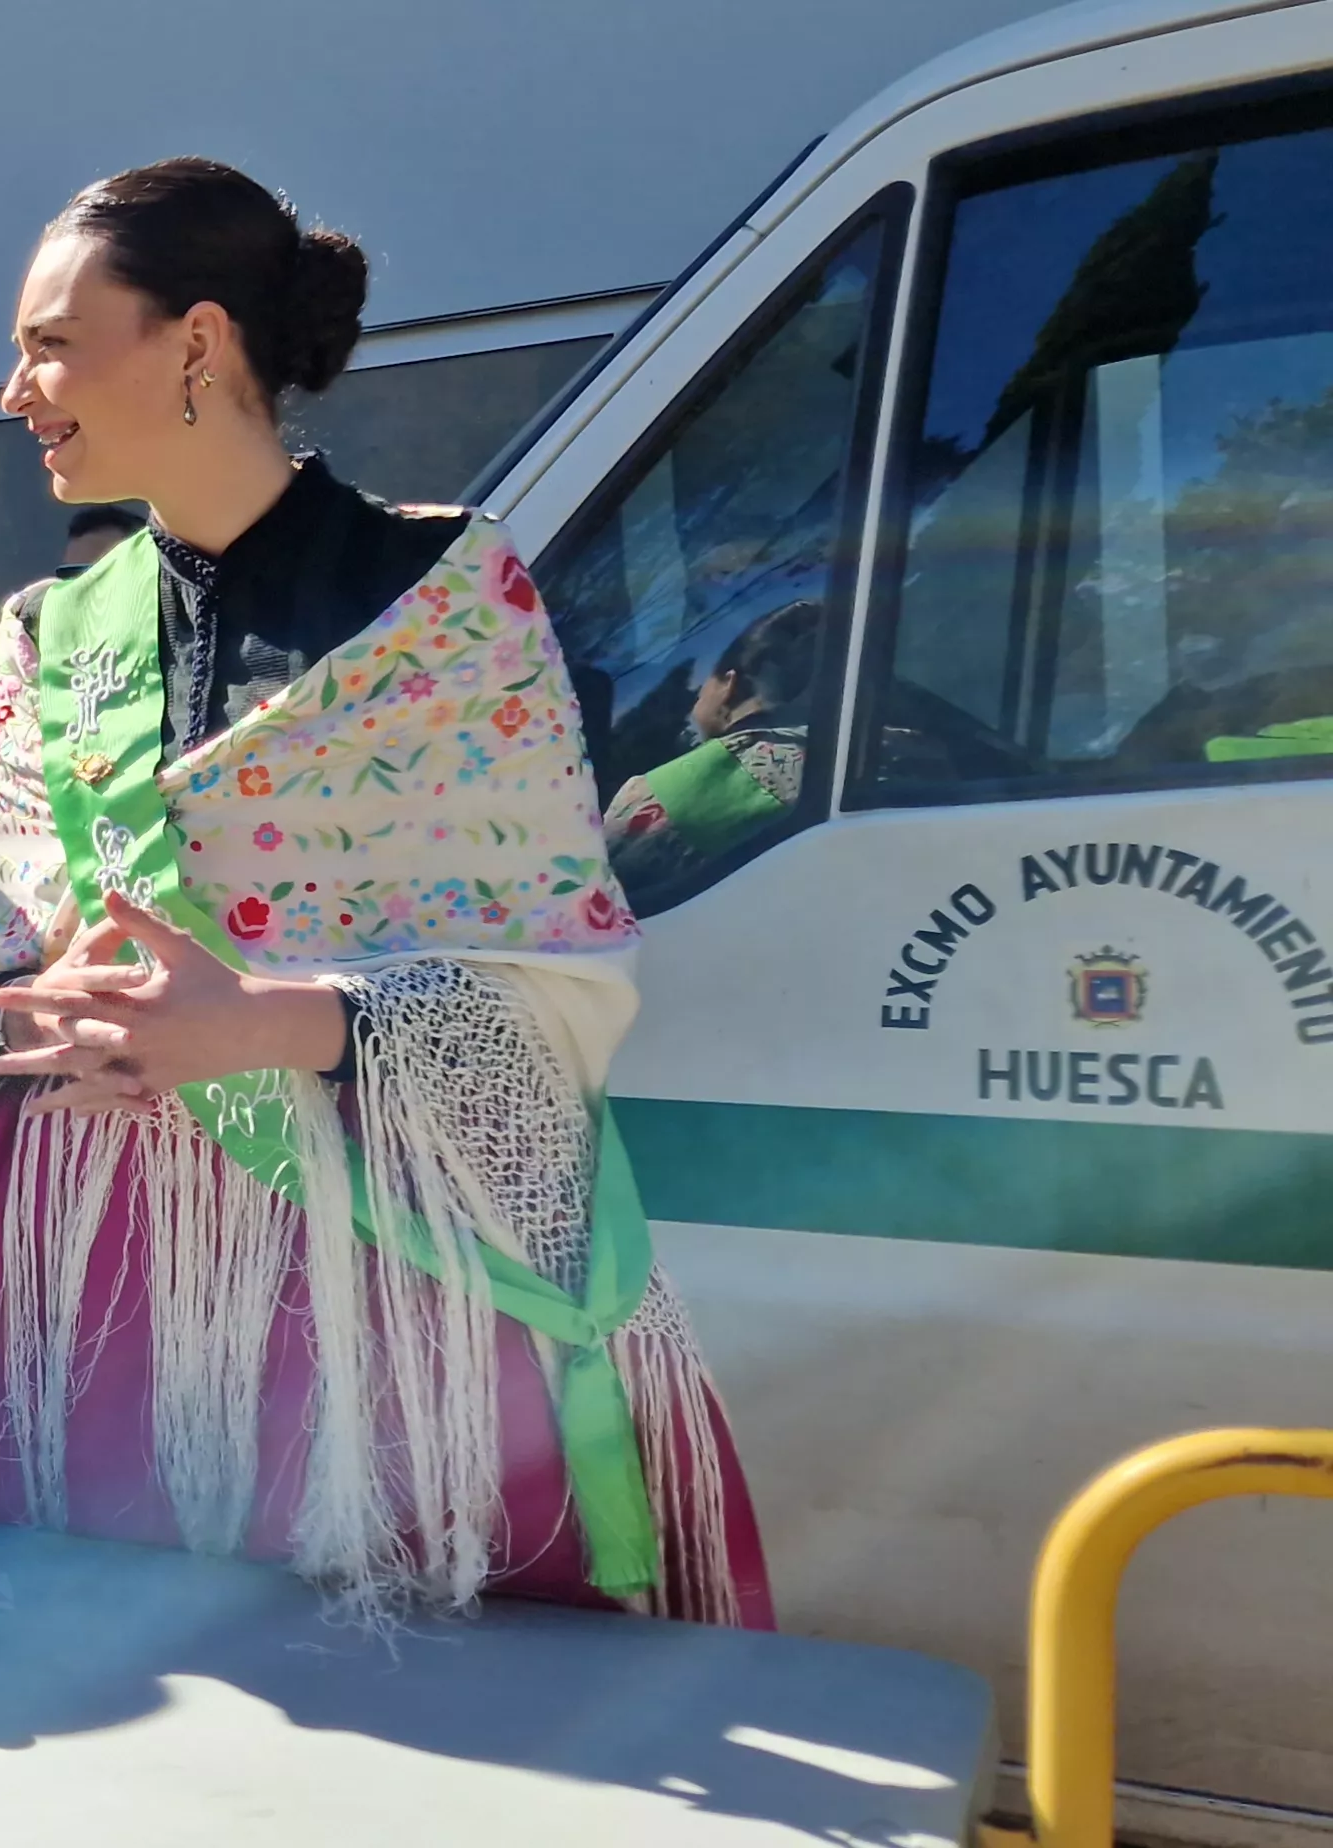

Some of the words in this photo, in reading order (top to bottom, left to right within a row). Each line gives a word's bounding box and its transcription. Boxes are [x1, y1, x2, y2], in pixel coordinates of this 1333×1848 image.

[881, 883, 996, 1030] EXCMO
[1020, 843, 1333, 1046] AYUNTAMIENTO
[978, 1048, 1224, 1110] HUESCA
